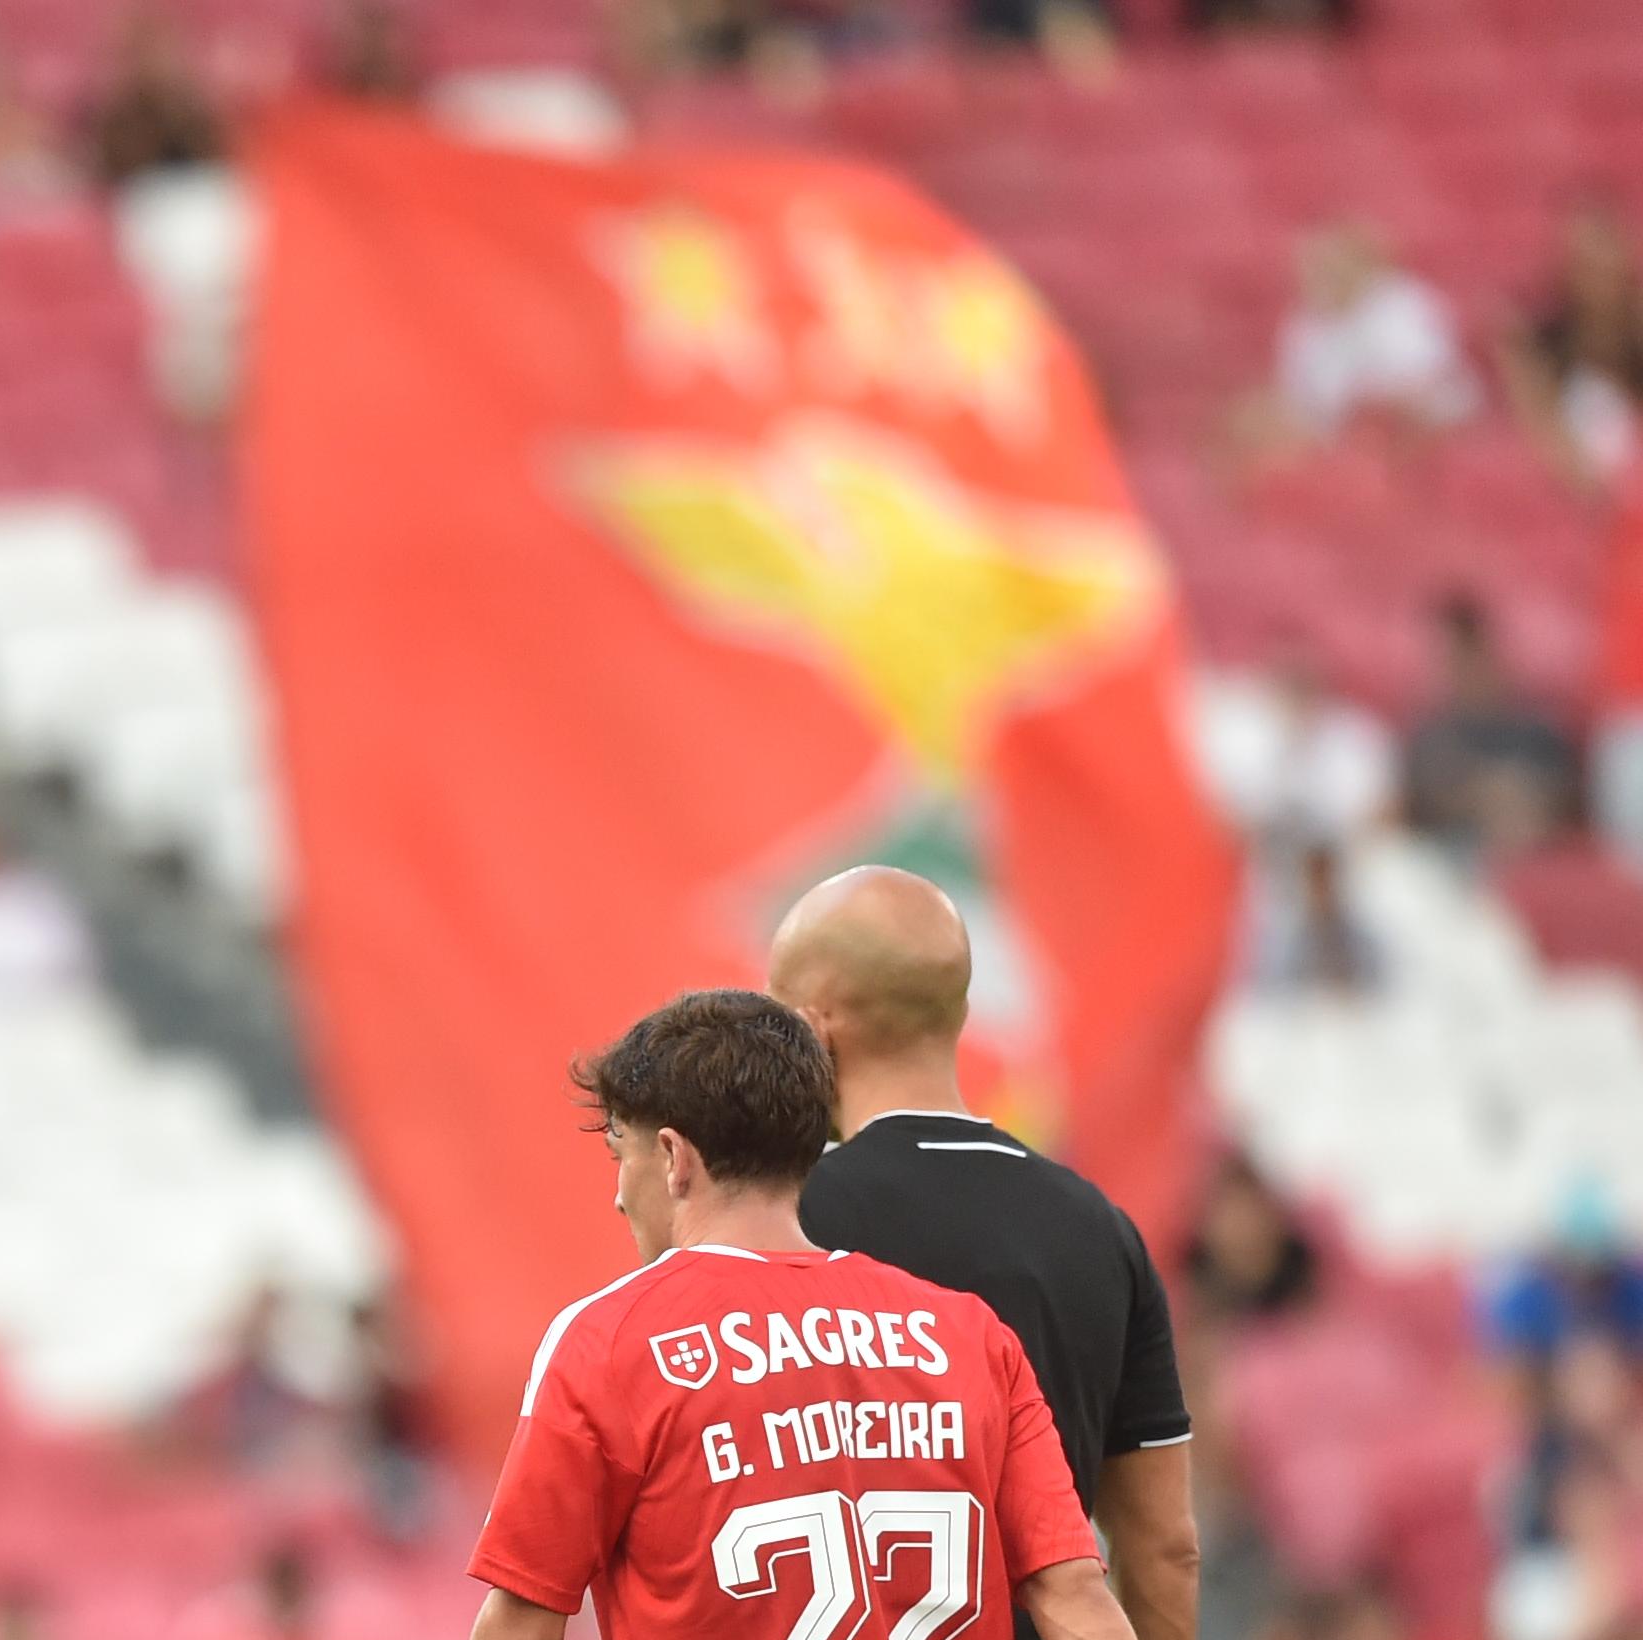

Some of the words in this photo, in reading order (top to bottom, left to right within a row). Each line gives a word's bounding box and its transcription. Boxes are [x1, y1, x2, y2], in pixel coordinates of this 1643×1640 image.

[719, 1307, 949, 1384] SAGRES
[701, 1422, 754, 1483] G.
[762, 1400, 965, 1470] MOREIRA
